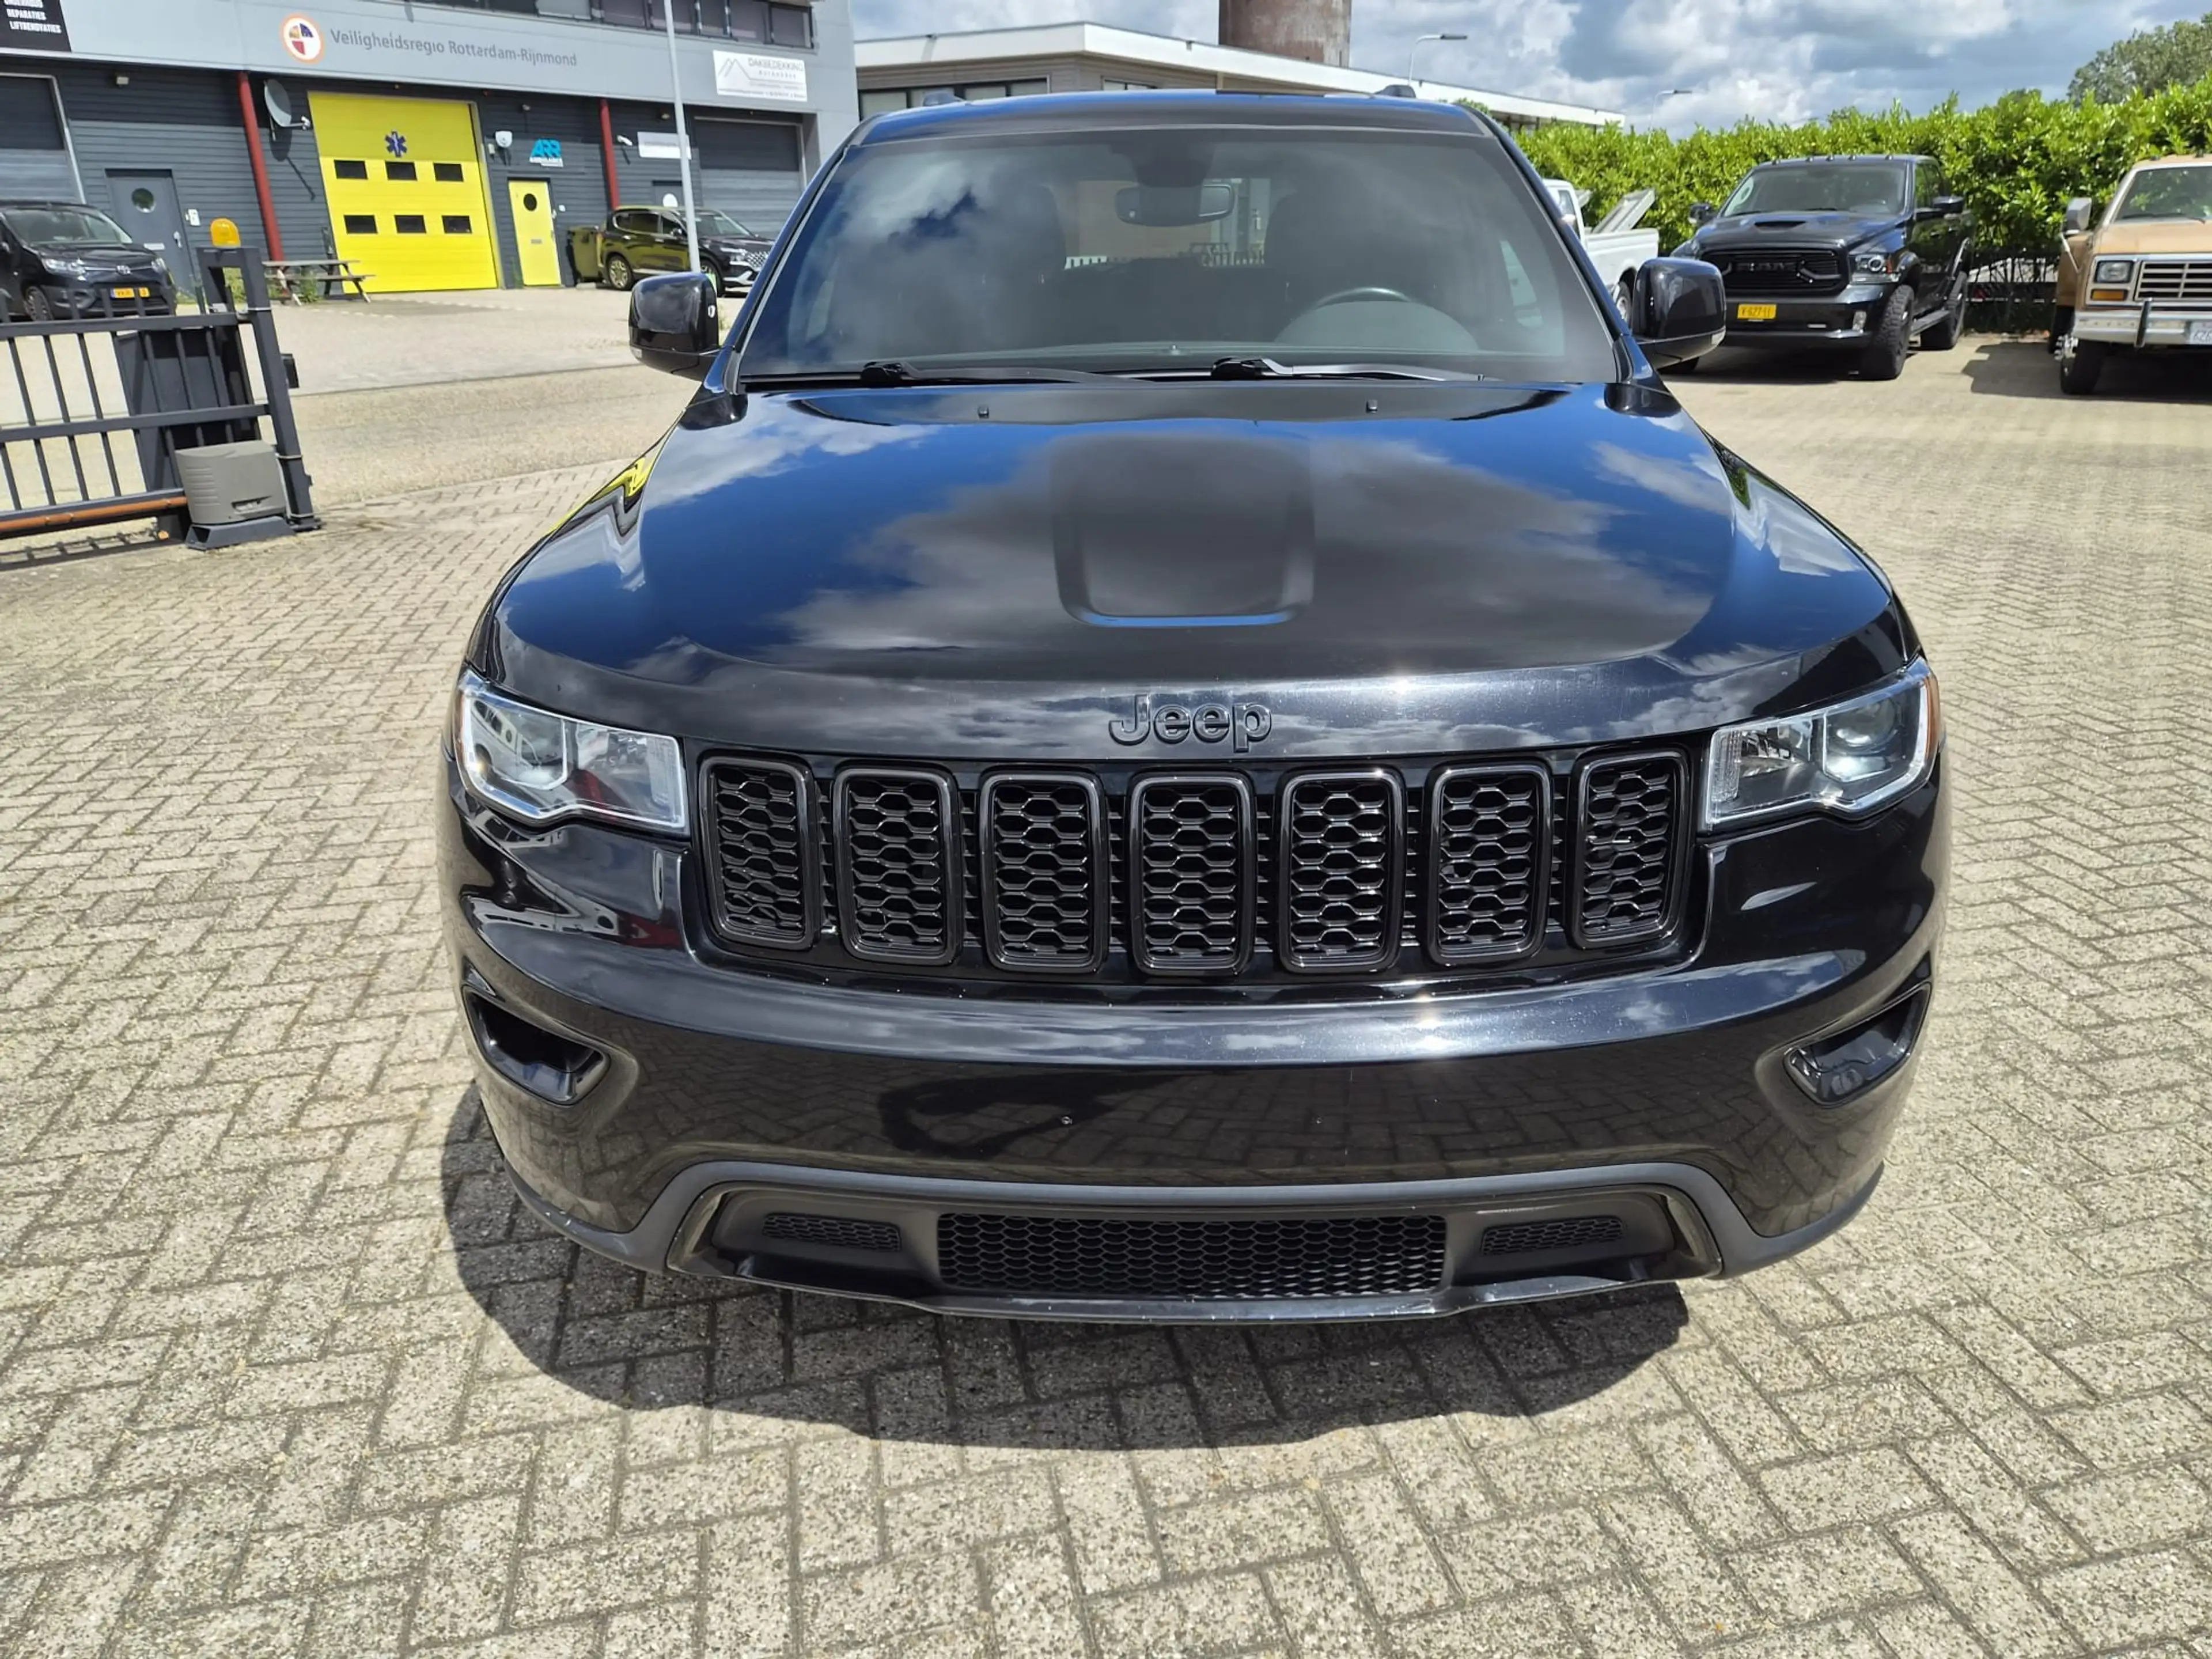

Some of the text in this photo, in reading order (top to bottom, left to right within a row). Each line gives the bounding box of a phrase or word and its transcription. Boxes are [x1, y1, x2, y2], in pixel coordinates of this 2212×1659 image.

[331, 29, 577, 66] Veiligheidsregio Rotterdam-Rijnmond
[1108, 693, 1272, 753] Jeep
